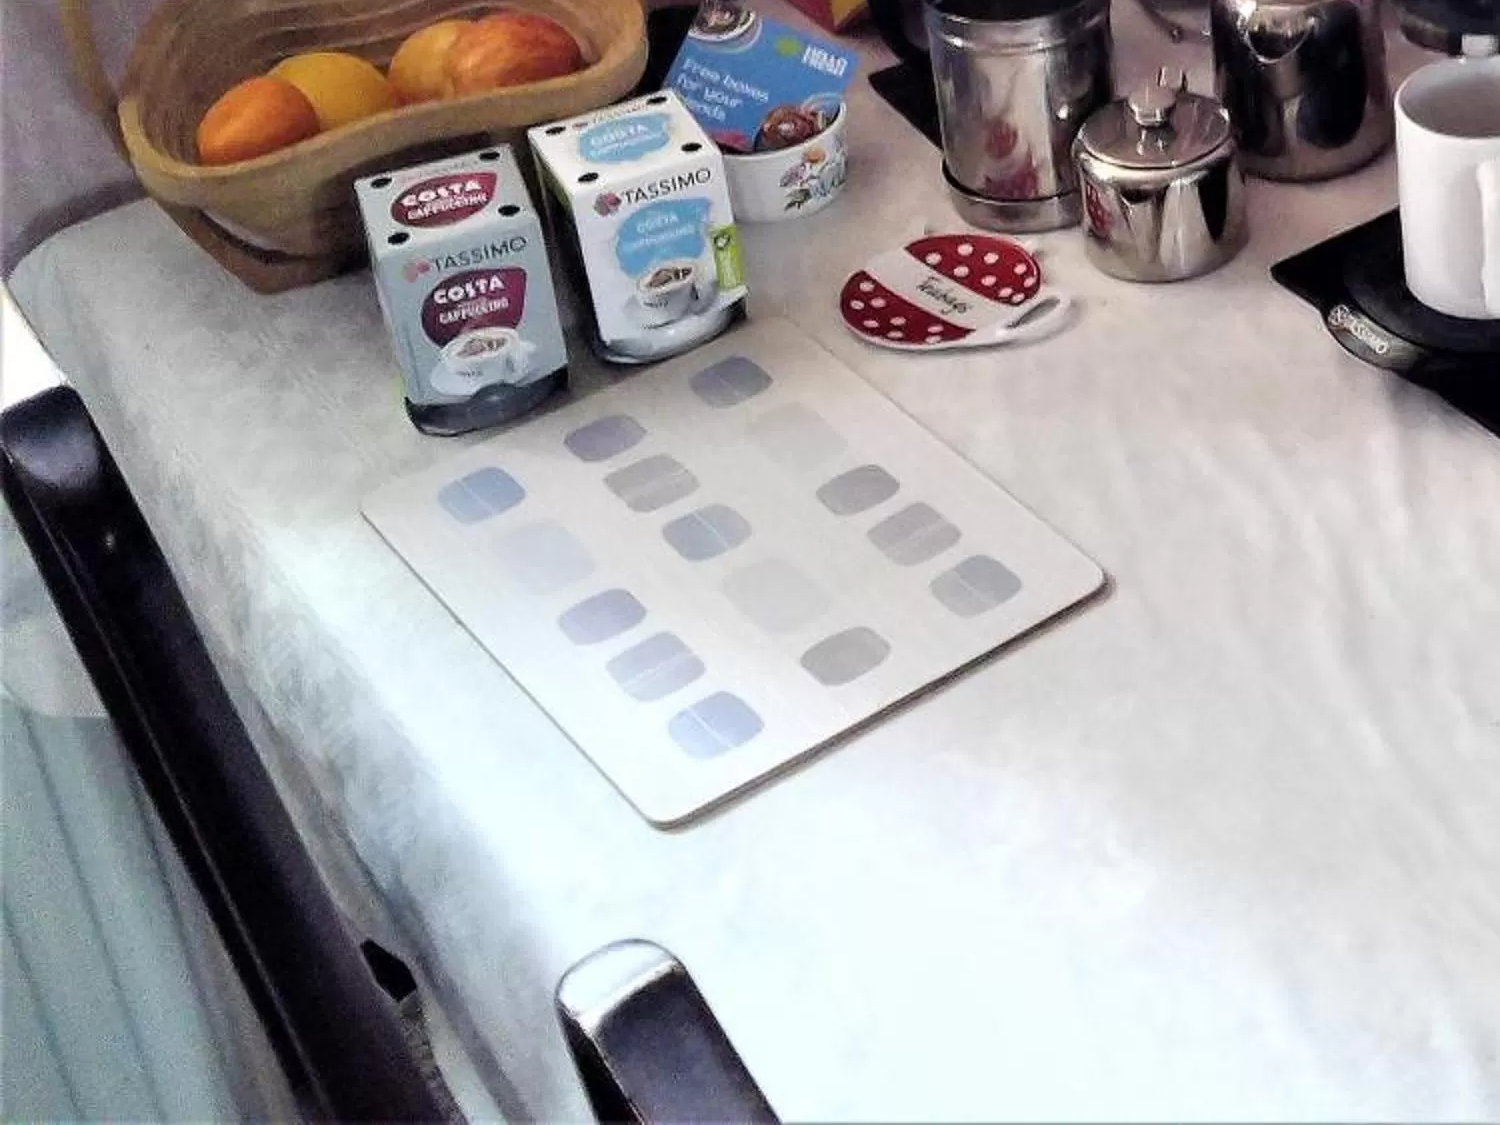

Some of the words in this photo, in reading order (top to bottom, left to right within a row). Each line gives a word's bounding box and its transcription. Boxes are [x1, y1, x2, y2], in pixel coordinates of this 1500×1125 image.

[401, 180, 482, 207] COSTA
[622, 168, 711, 204] TASSIMO
[433, 236, 527, 271] TASSIMO
[434, 275, 505, 304] COSTA
